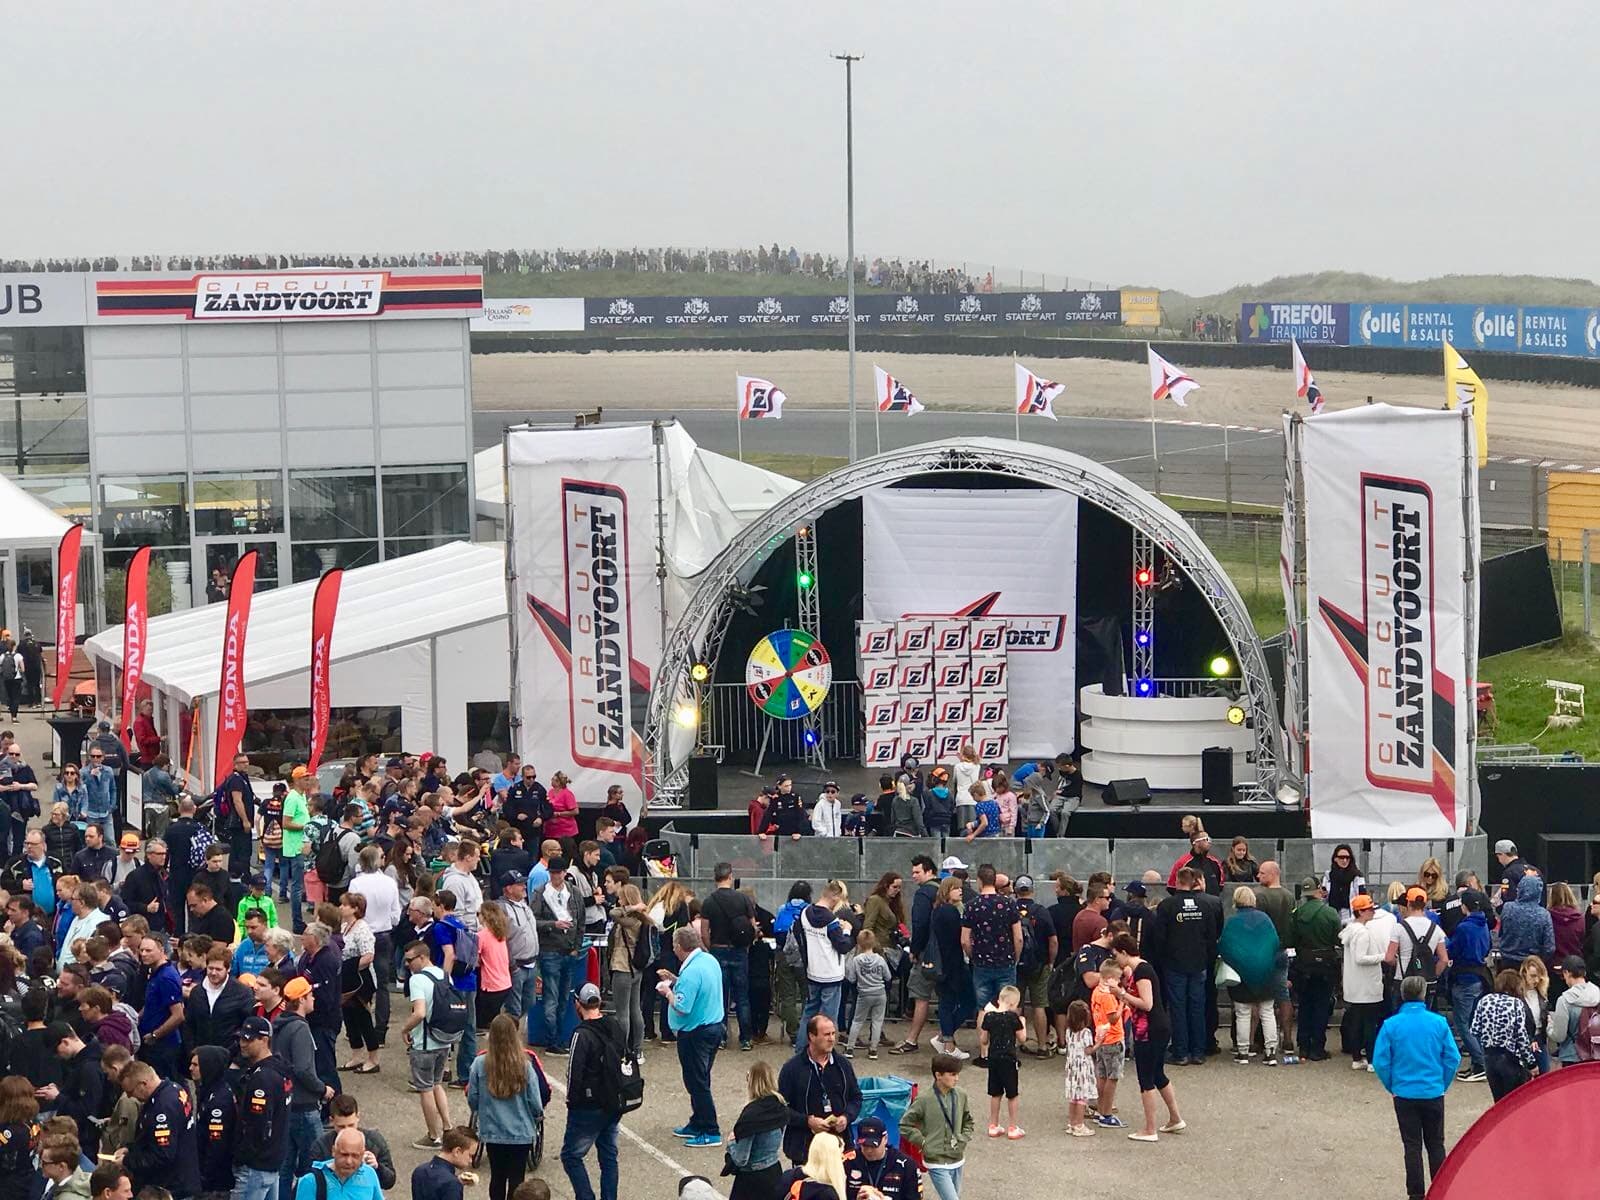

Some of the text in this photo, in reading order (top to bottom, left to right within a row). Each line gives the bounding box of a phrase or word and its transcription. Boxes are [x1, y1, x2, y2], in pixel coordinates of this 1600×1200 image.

[207, 280, 374, 291] CIRCUIT
[203, 291, 373, 311] ZANDVOORT
[590, 316, 618, 324] STATE
[630, 316, 654, 324] ART
[739, 315, 770, 323] STATE
[781, 315, 800, 323] ART
[880, 314, 909, 322] STATE
[917, 314, 935, 322] ART
[944, 314, 972, 322] STATE
[1040, 312, 1056, 320] ART
[1066, 312, 1092, 320] STATE
[1100, 312, 1118, 320] ART
[1270, 304, 1336, 325] TREFOIL
[1410, 312, 1454, 325] RENTAL
[1361, 309, 1401, 340] Collé
[1474, 310, 1515, 343] Collé
[1525, 316, 1567, 331] RENTAL
[1270, 325, 1336, 339] TRADING BV
[1410, 329, 1454, 342] & SALS
[1525, 333, 1568, 348] & SALES
[752, 388, 767, 409] Z
[573, 503, 597, 746] CIRCUIT
[590, 505, 624, 750] ZANDVOORT
[1374, 499, 1394, 764] CIRCUIT
[872, 636, 885, 649] Z
[909, 634, 922, 648] Z
[946, 634, 959, 647] Z
[982, 634, 996, 647] Z
[1391, 502, 1425, 769] ZANDVOORT
[224, 610, 240, 731] HONDA
[908, 671, 922, 684] Z
[947, 670, 960, 684] Z
[984, 670, 997, 683] Z
[875, 672, 888, 686] Z
[878, 709, 890, 722] Z
[910, 706, 924, 720] Z
[948, 706, 961, 720] Z
[984, 706, 997, 720] Z
[912, 743, 925, 756] Z
[946, 738, 960, 751] Z
[985, 742, 998, 756] Z
[878, 746, 890, 758] Z
